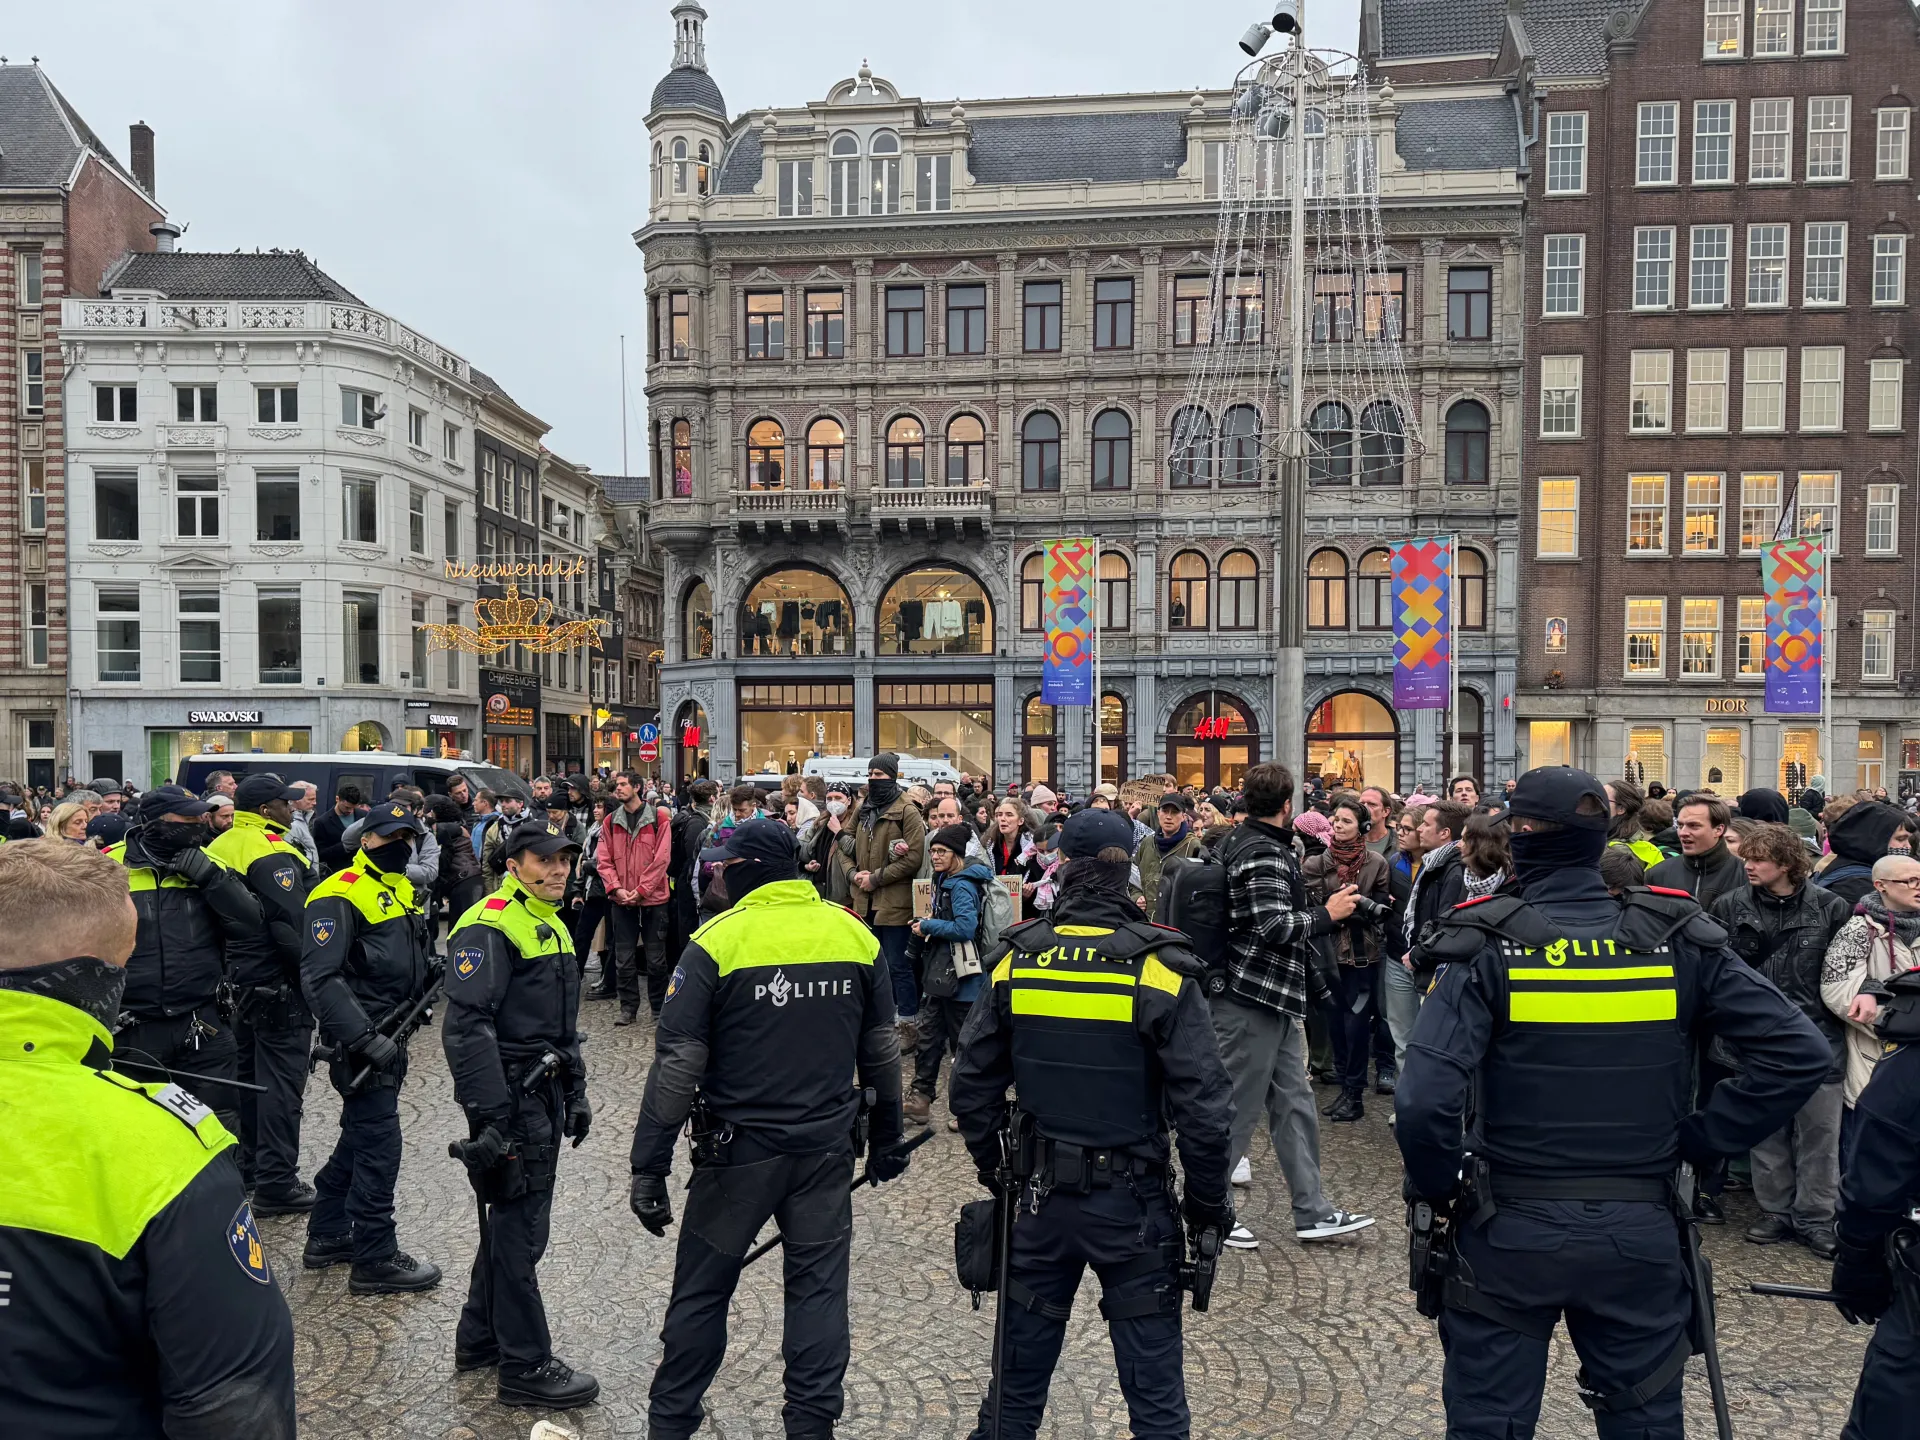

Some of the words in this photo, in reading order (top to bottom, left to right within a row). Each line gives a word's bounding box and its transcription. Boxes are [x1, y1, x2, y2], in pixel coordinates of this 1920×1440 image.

[0, 205, 52, 220] EGEN
[445, 555, 585, 581] Nieuwendijk
[1706, 699, 1749, 712] DIOR
[190, 711, 259, 722] SWAROVSKI
[429, 714, 458, 726] SWAROVSKI
[1193, 716, 1230, 740] H&M
[457, 949, 481, 958] POLITIE
[754, 973, 852, 1007] POLITIE
